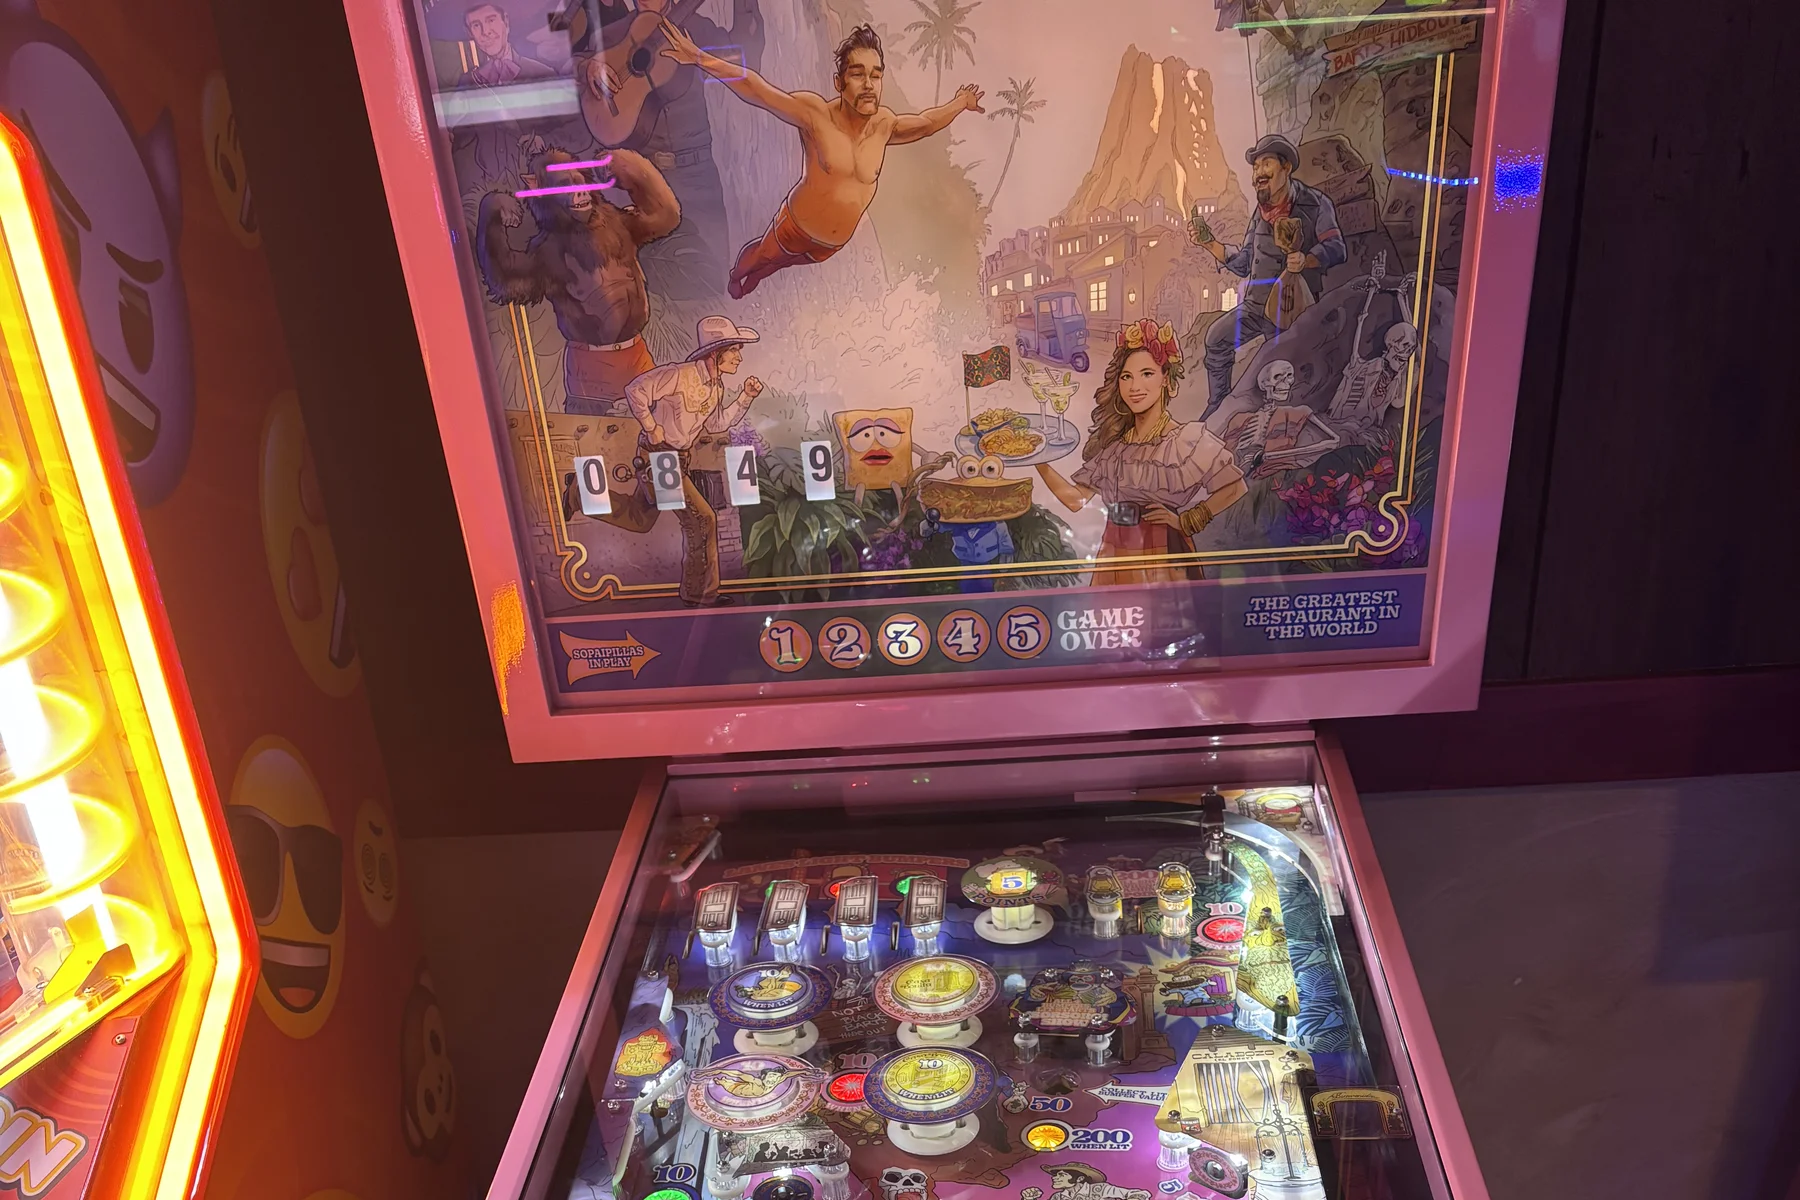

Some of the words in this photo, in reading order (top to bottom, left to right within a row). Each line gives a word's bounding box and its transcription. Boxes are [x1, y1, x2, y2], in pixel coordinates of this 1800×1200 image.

[583, 458, 607, 496] 0
[655, 452, 681, 490] 8
[737, 449, 757, 486] 4
[808, 445, 832, 482] 9
[1250, 596, 1290, 611] THE
[1293, 589, 1398, 608] GREATEST
[1057, 605, 1145, 631] GAME
[1245, 608, 1375, 626] RESTAURANT
[1378, 605, 1400, 619] IN
[1265, 625, 1304, 640] THE
[1308, 621, 1378, 637] WORLD
[769, 627, 799, 666] 1
[827, 627, 864, 661] 2
[884, 621, 924, 661] 3
[943, 617, 981, 656] 4
[1007, 615, 1042, 652] 5
[1060, 627, 1143, 651] OVER
[572, 645, 645, 661] SOPAIPILLAS
[588, 657, 603, 669] IN
[602, 655, 633, 669] PLAY
[1002, 875, 1023, 889] 5
[973, 893, 1044, 906] POINTS
[1206, 902, 1243, 915] 10
[759, 969, 779, 978] 10
[743, 999, 775, 1008] WHEN
[776, 997, 794, 1006] LIT
[832, 1005, 863, 1017] NOT
[841, 1011, 887, 1024] BLACK
[866, 1026, 886, 1036] OUT
[839, 1052, 877, 1069] 10
[919, 1058, 943, 1069] 10
[900, 1089, 933, 1099] WHEN
[934, 1088, 955, 1097] LIT
[1029, 1096, 1073, 1112] 50
[1071, 1128, 1131, 1144] 200
[654, 1163, 696, 1184] 10
